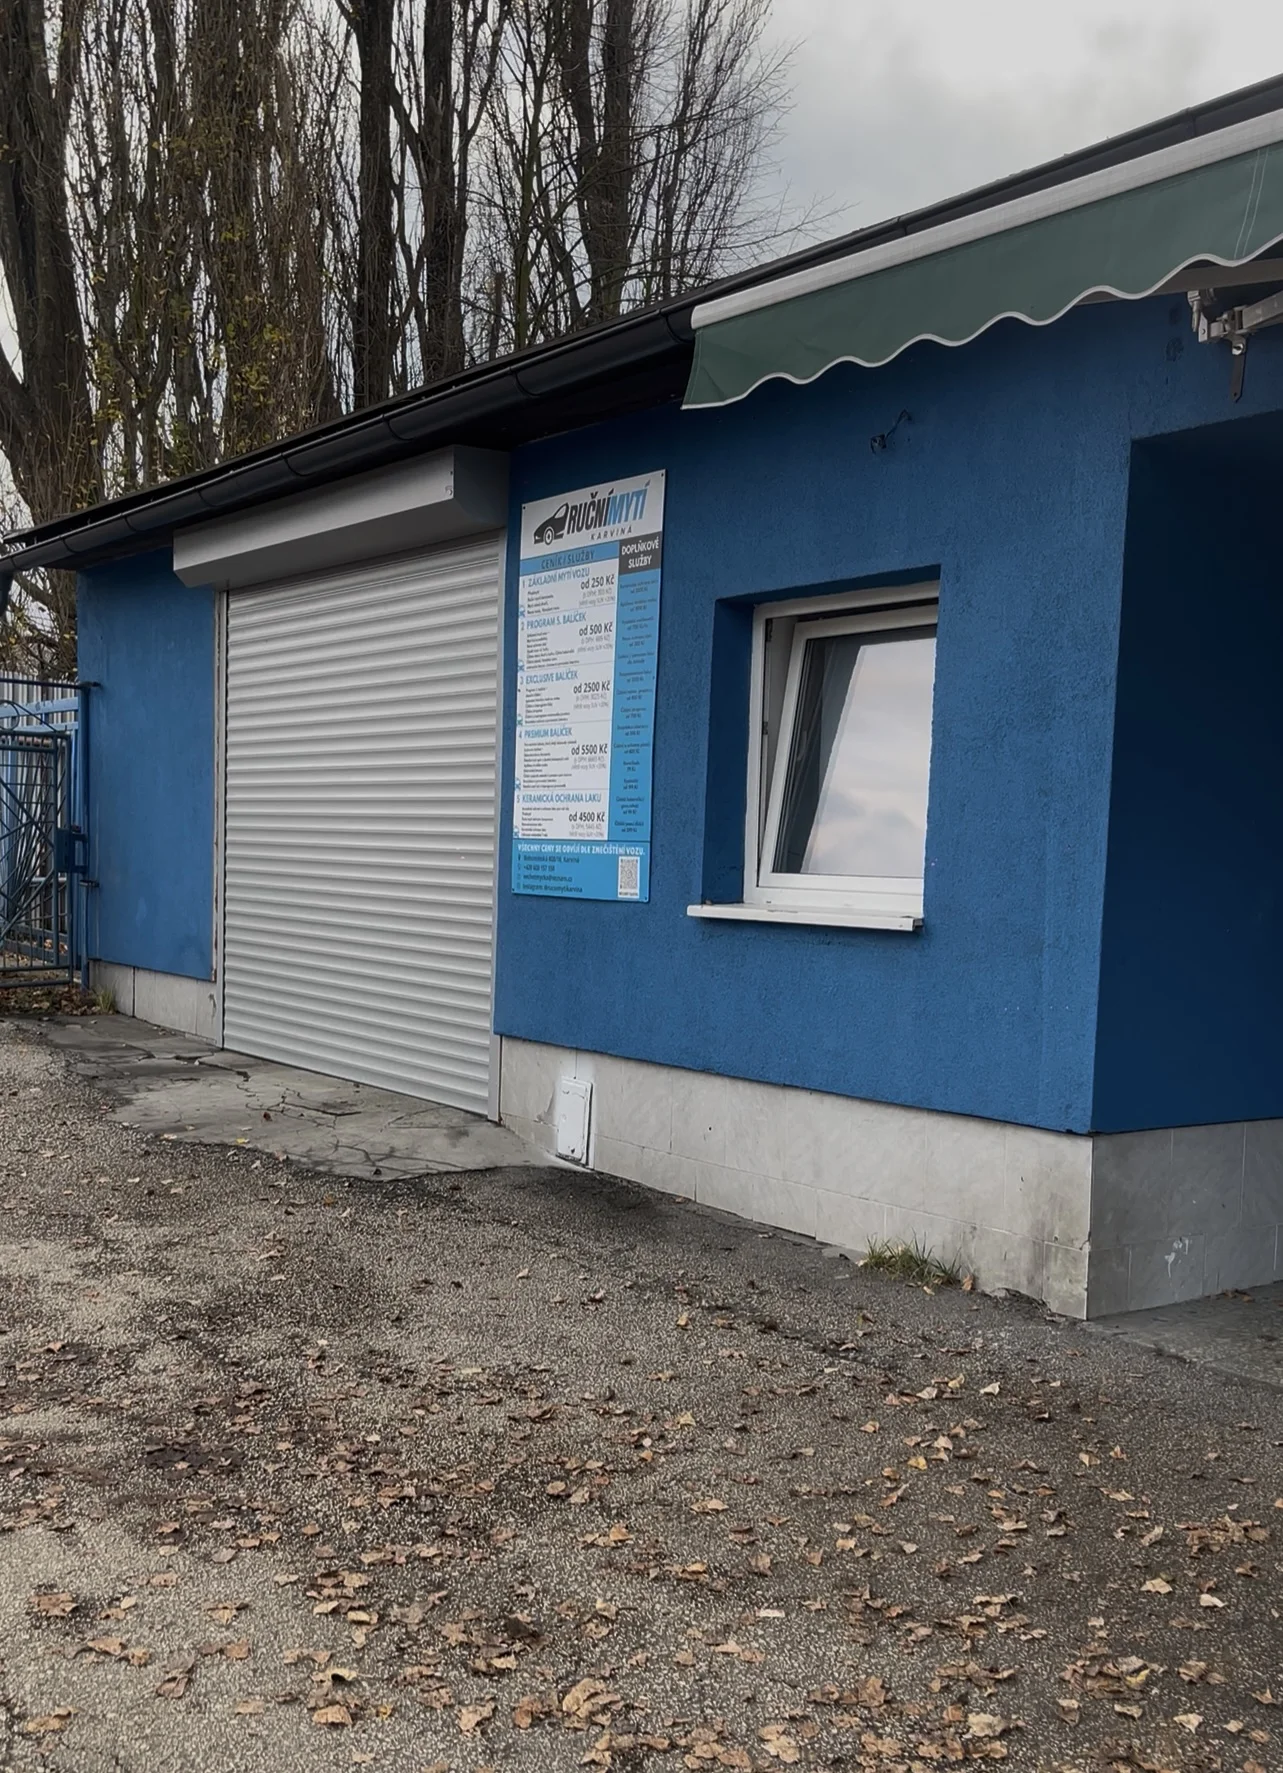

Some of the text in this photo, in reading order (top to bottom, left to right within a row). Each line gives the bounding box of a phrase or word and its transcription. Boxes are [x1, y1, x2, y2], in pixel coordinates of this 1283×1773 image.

[591, 525, 632, 540] KARVINÁ
[622, 538, 659, 554] DOPLŇKOVÉ
[541, 554, 562, 570] CENÍK
[567, 550, 595, 564] SLUŽBY
[628, 556, 652, 568] SLUŽBY
[528, 572, 557, 587] ZÁKLADNÍ
[558, 570, 572, 582] MYTÍ
[572, 568, 590, 579] VOZU
[581, 574, 614, 590] od 250 Kč
[527, 617, 555, 629] PROGRAM
[563, 610, 586, 624] BALÍČEK
[579, 625, 588, 636] od
[590, 624, 602, 635] 500
[604, 622, 612, 633] Kč
[526, 672, 554, 684] EXCLUSIVE
[555, 668, 578, 681] BALÍČEK
[573, 680, 610, 694] od 2500 Kč
[525, 729, 550, 738] PREMIUM
[550, 724, 572, 736] BALÍČEK
[571, 744, 580, 755] od
[581, 744, 597, 755] 5500
[599, 744, 607, 754] Kč
[523, 792, 554, 803] KERAMICKÁ
[555, 794, 583, 803] OCHRANA
[585, 794, 601, 803] LAKU
[569, 811, 605, 822] od 4500 Kč
[518, 842, 540, 852] VŠECHNY
[562, 843, 580, 853] ODVÍJÍ
[581, 845, 590, 854] DLE
[592, 844, 625, 855] ZNEČIŠTĚNÍ
[626, 846, 645, 856] VOZU.
